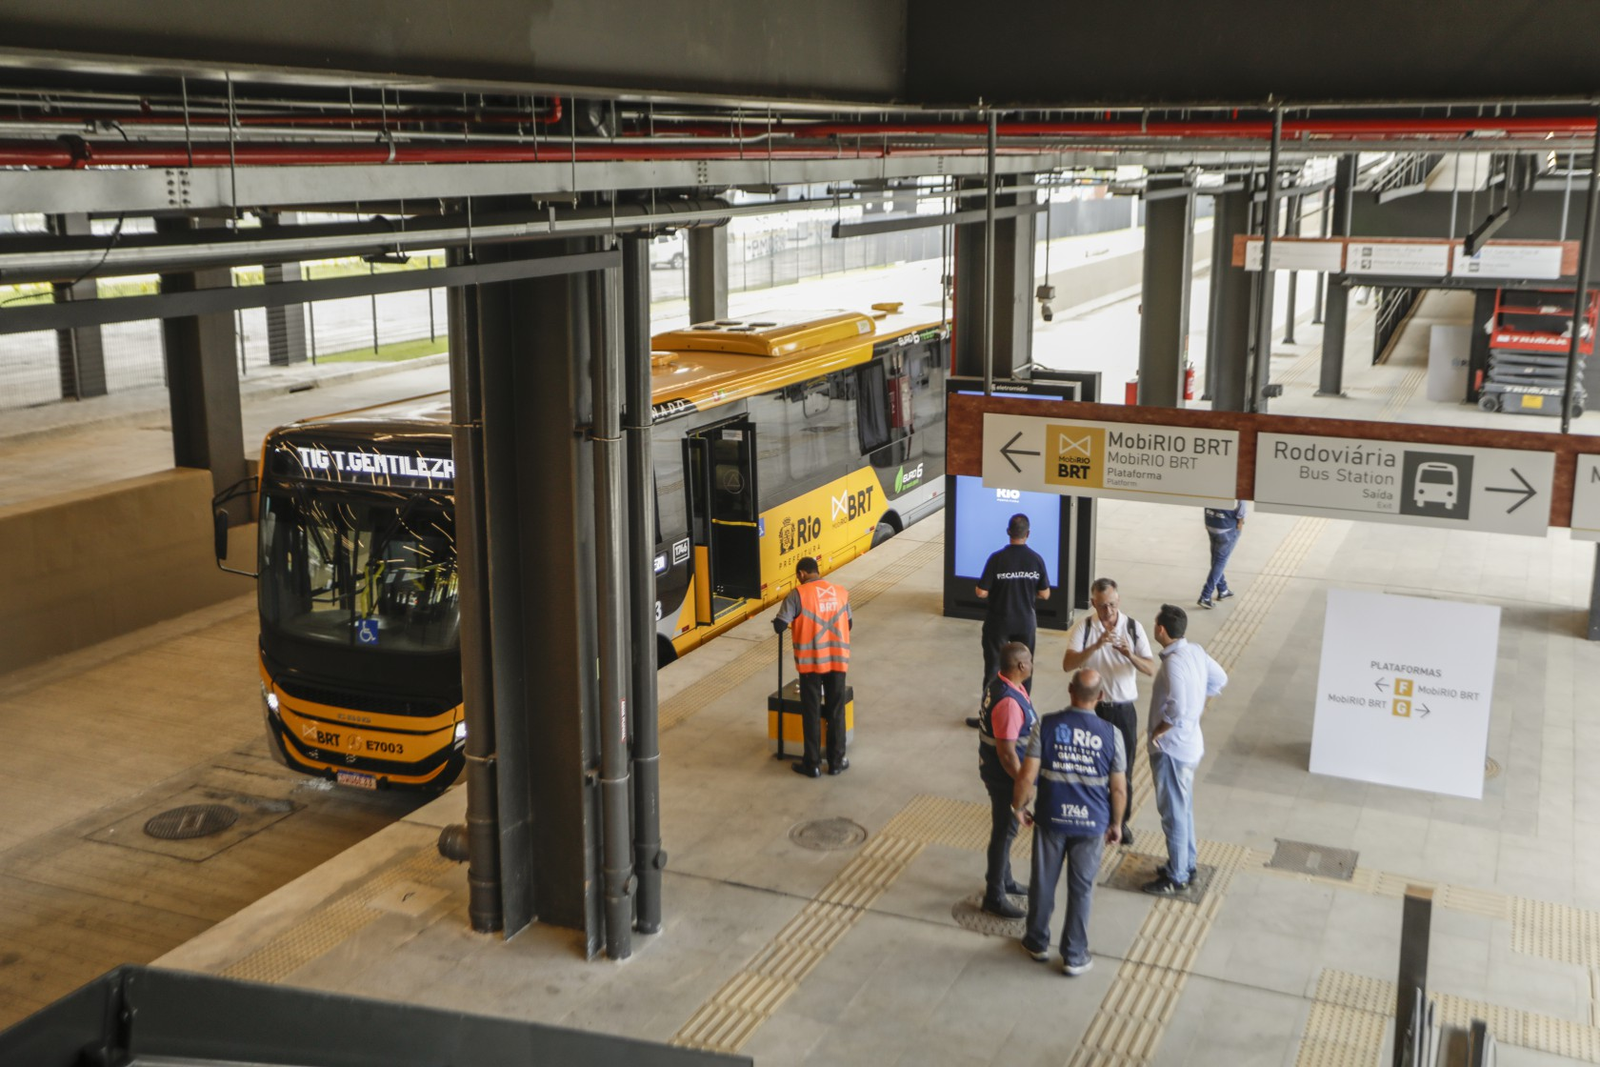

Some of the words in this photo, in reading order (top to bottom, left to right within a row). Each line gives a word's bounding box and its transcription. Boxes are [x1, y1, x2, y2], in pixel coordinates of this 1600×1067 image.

[1108, 431, 1186, 452] MobiRIO
[1194, 438, 1232, 456] BRT
[297, 446, 330, 468] TIG
[1059, 456, 1090, 464] MobiRIO
[1108, 451, 1164, 468] MobiRIO
[1170, 456, 1198, 470] BRT
[1274, 440, 1396, 467] Rodoviária
[1058, 464, 1091, 480] BRT
[1107, 468, 1162, 480] Plataforma
[1300, 465, 1330, 480] Bus
[1336, 468, 1394, 486] Station
[1106, 478, 1138, 486] Platform
[1362, 488, 1394, 500] Saída
[848, 486, 874, 522] BRT
[1376, 502, 1392, 510] Exit
[797, 515, 821, 548] Rio
[674, 542, 688, 556] 1746
[819, 602, 838, 612] BRT
[1370, 660, 1442, 678] PLATAFORMAS
[1400, 681, 1408, 694] F
[1418, 685, 1458, 698] MobiRIO
[1460, 690, 1480, 700] BRT
[1328, 694, 1366, 706] MobiRIO
[1368, 698, 1386, 708] BRT
[1396, 702, 1406, 715] G
[316, 730, 340, 746] BRT
[1073, 728, 1102, 750] Rio
[366, 740, 404, 754] E7003
[1054, 744, 1100, 758] PREFEITURA
[1058, 752, 1094, 764] GUARDA
[1052, 761, 1098, 776] MUNICIPAL
[1060, 804, 1089, 818] 1746
